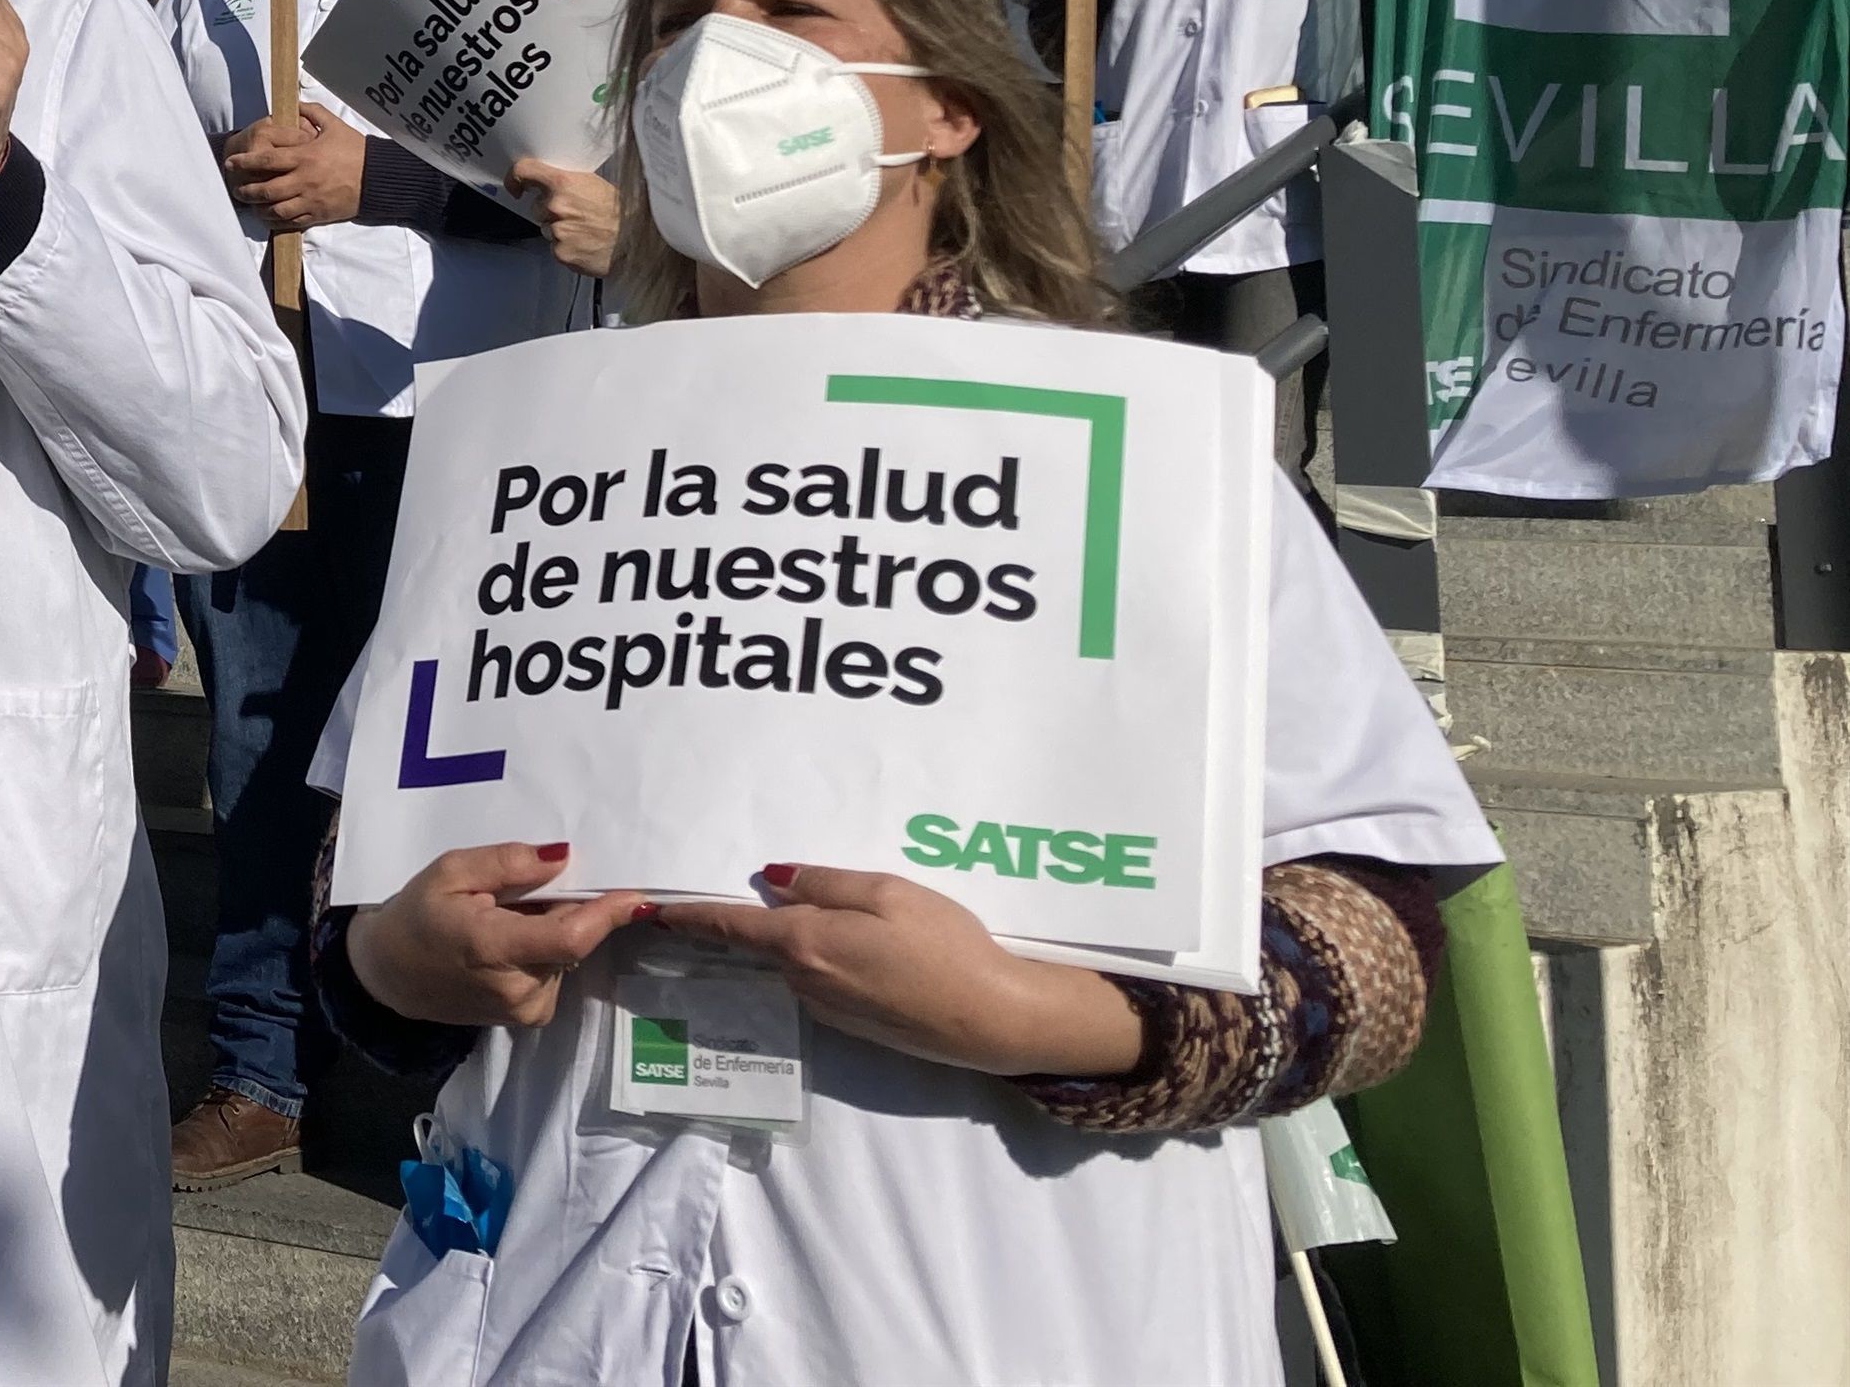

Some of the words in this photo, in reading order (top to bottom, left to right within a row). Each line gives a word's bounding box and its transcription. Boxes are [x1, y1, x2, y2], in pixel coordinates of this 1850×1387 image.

[363, 73, 405, 117] Por
[384, 48, 426, 85] la
[399, 109, 434, 144] de
[1500, 246, 1738, 301] Sindicato
[1558, 296, 1829, 353] Enfermería
[490, 462, 626, 535] Por
[643, 448, 717, 521] la
[742, 446, 1022, 533] salud
[476, 540, 579, 617] de
[600, 533, 1039, 623] nuestros
[466, 610, 946, 712] hospitales
[900, 812, 1159, 891] SATSE
[634, 1062, 686, 1080] SATSE
[693, 1055, 712, 1071] de
[714, 1054, 796, 1076] Enfermería
[693, 1073, 731, 1090] Sevilla
